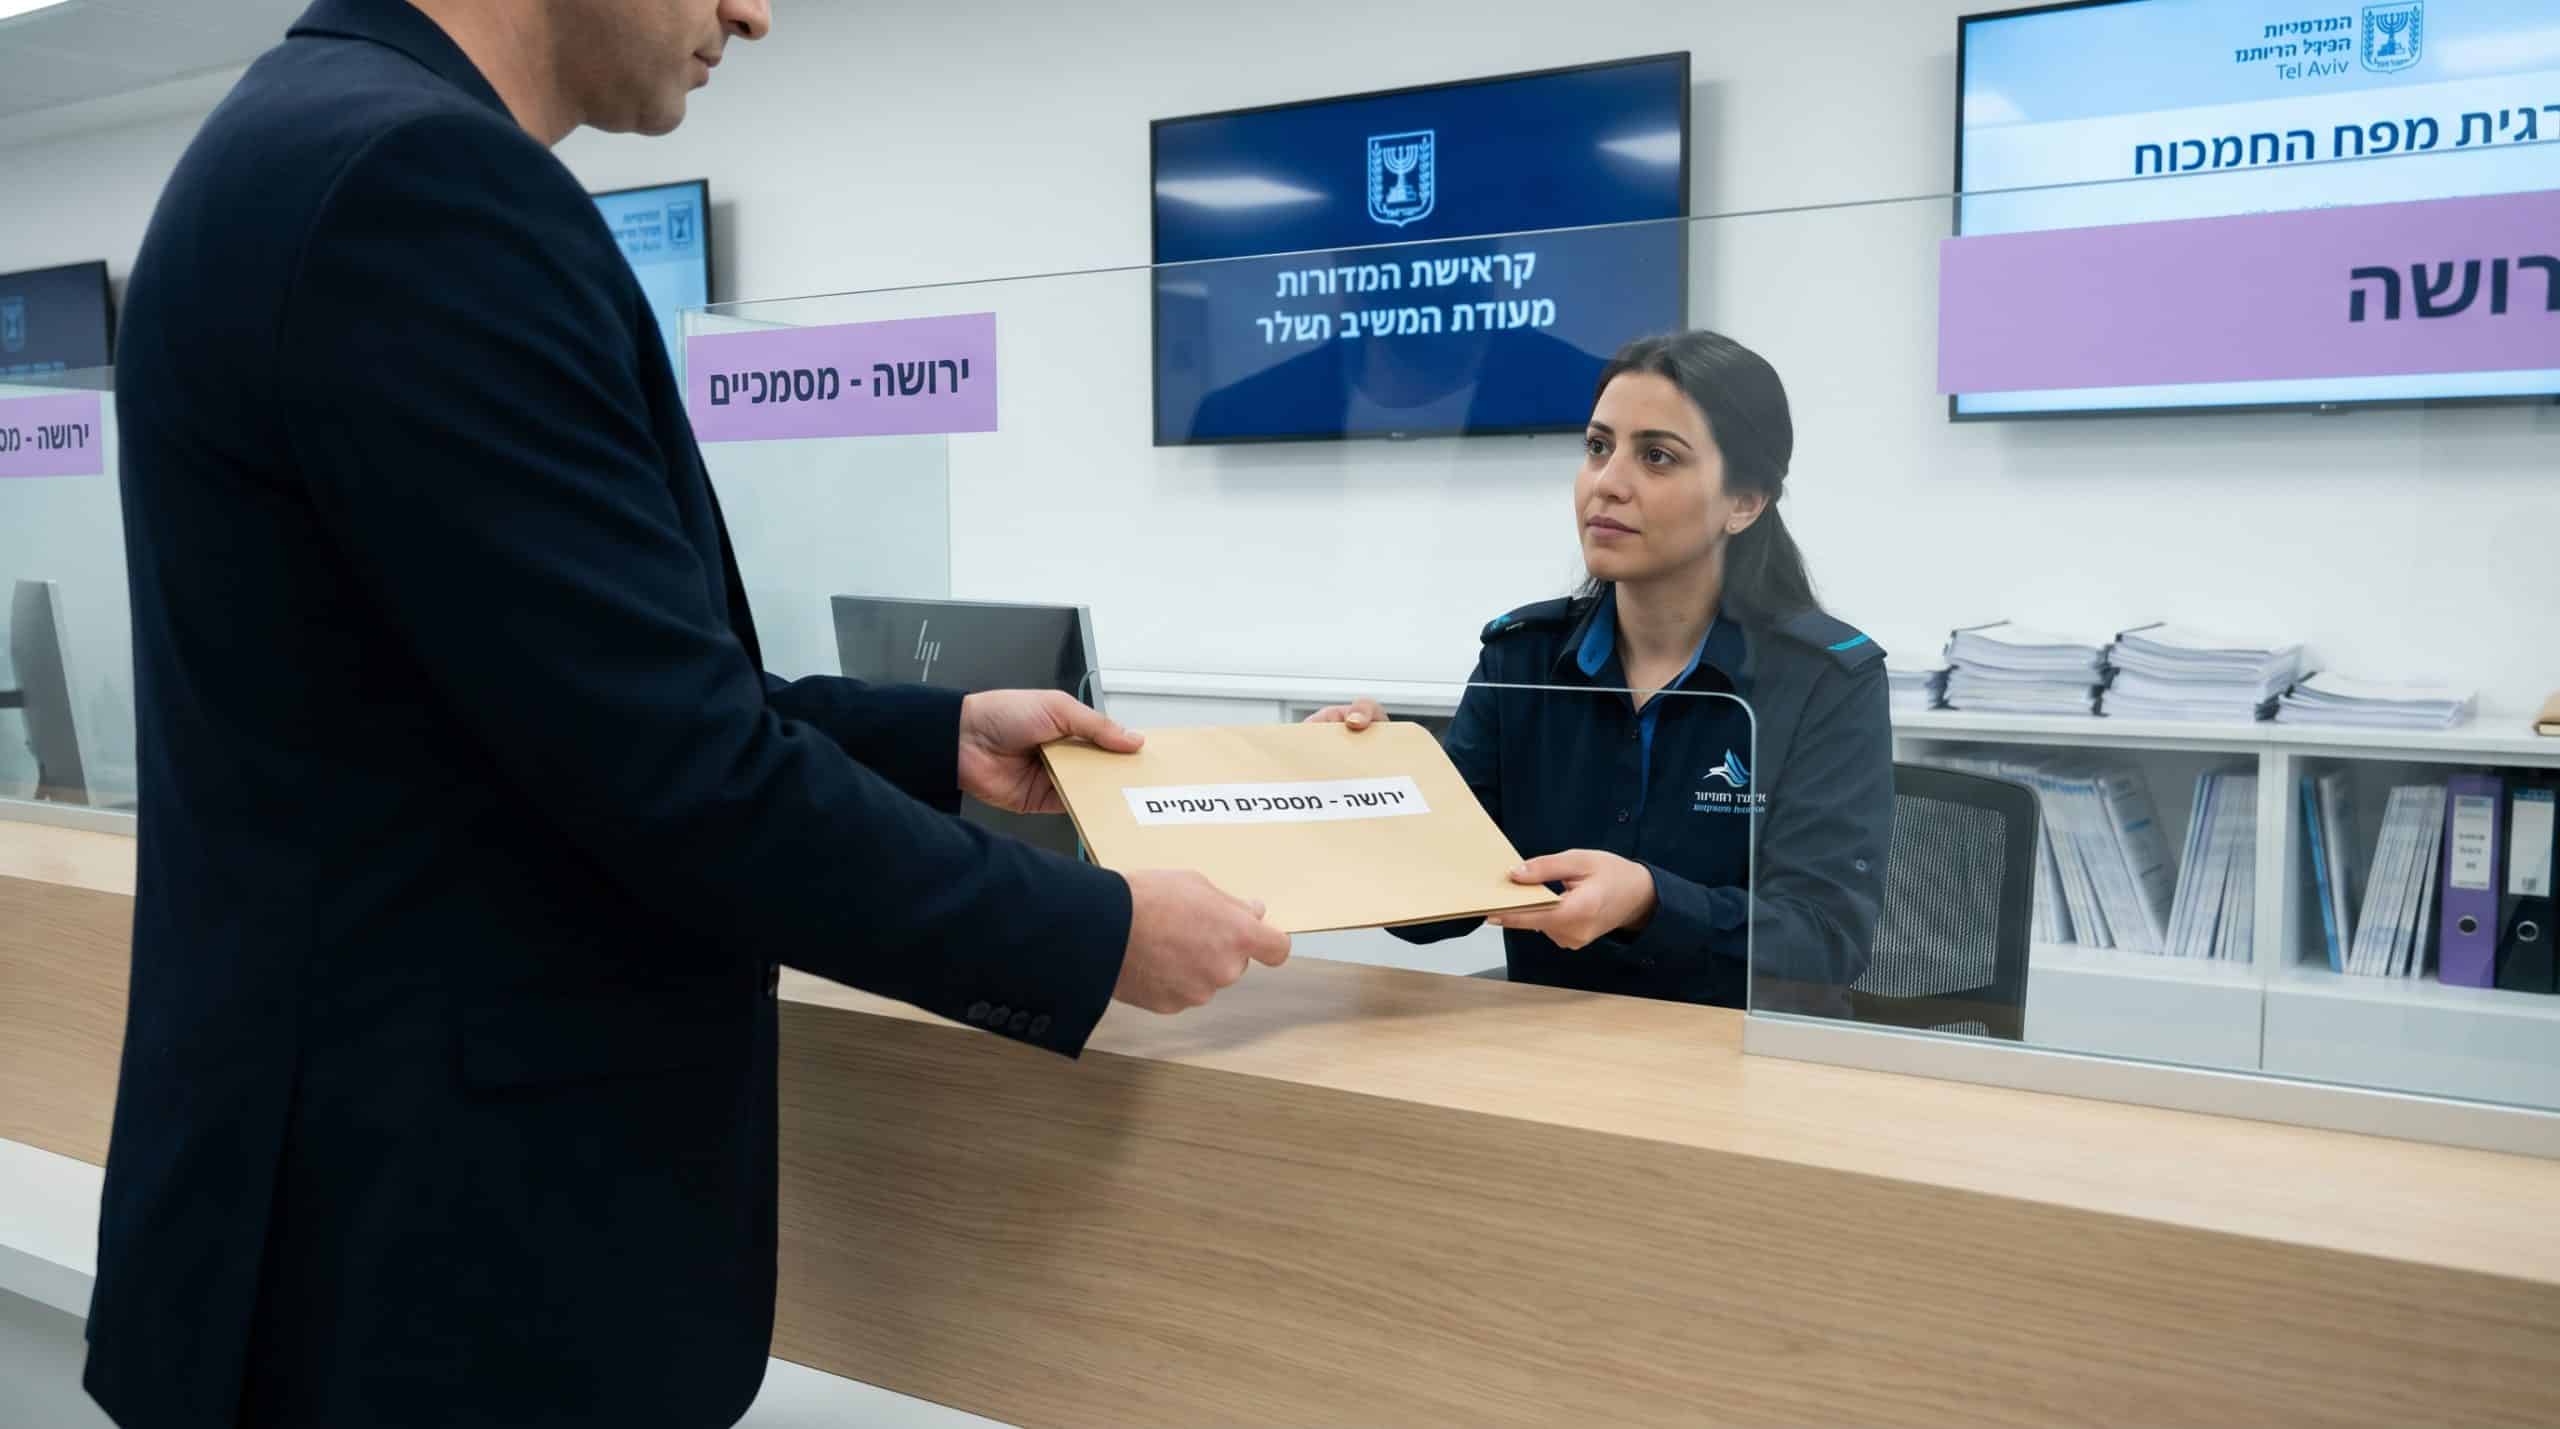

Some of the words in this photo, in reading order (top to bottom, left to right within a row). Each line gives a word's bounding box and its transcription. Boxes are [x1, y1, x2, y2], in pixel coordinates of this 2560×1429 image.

[2277, 62, 2302, 80] Tel
[2307, 58, 2350, 77] Aviv
[2334, 117, 2439, 157] מפח
[1277, 263, 1401, 298] המדורות
[1410, 252, 1536, 289] קראישת
[1340, 307, 1442, 339] המשיב
[1451, 298, 1556, 332] מעודת
[710, 367, 840, 405] מסמכיים
[873, 358, 969, 397] ירושה
[37, 424, 89, 449] ירושה
[1145, 797, 1231, 814] רשמיים
[1343, 788, 1406, 808] ירושה
